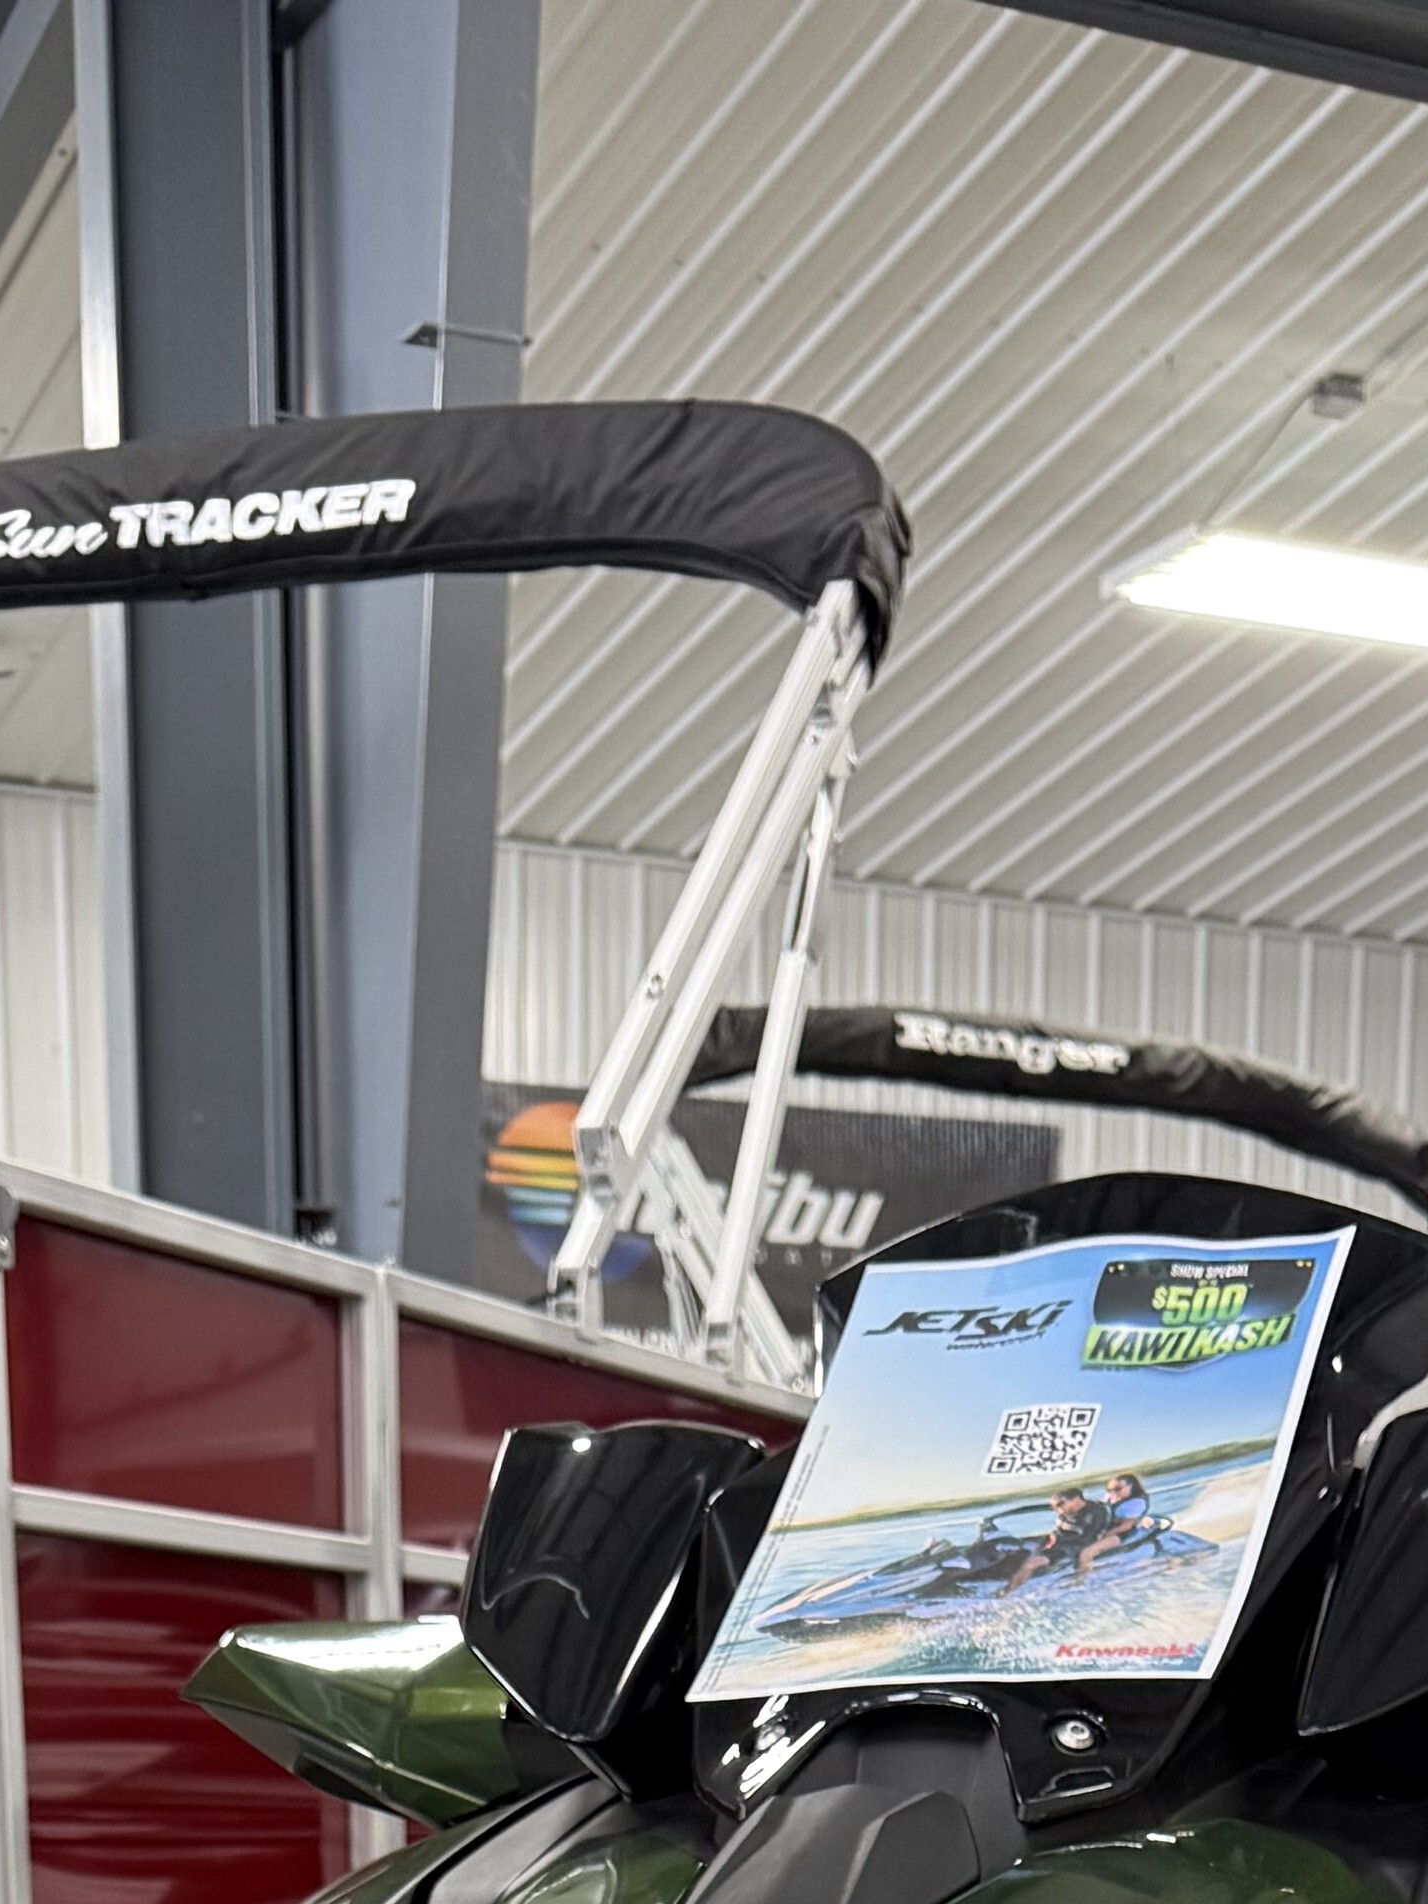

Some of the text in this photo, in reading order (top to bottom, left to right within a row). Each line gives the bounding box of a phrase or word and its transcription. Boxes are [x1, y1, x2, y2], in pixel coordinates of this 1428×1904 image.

[110, 478, 417, 548] TRACKER
[893, 1011, 1130, 1074] Ranger
[1152, 1283, 1248, 1326] $500
[1055, 1643, 1196, 1658] Kawasaki
